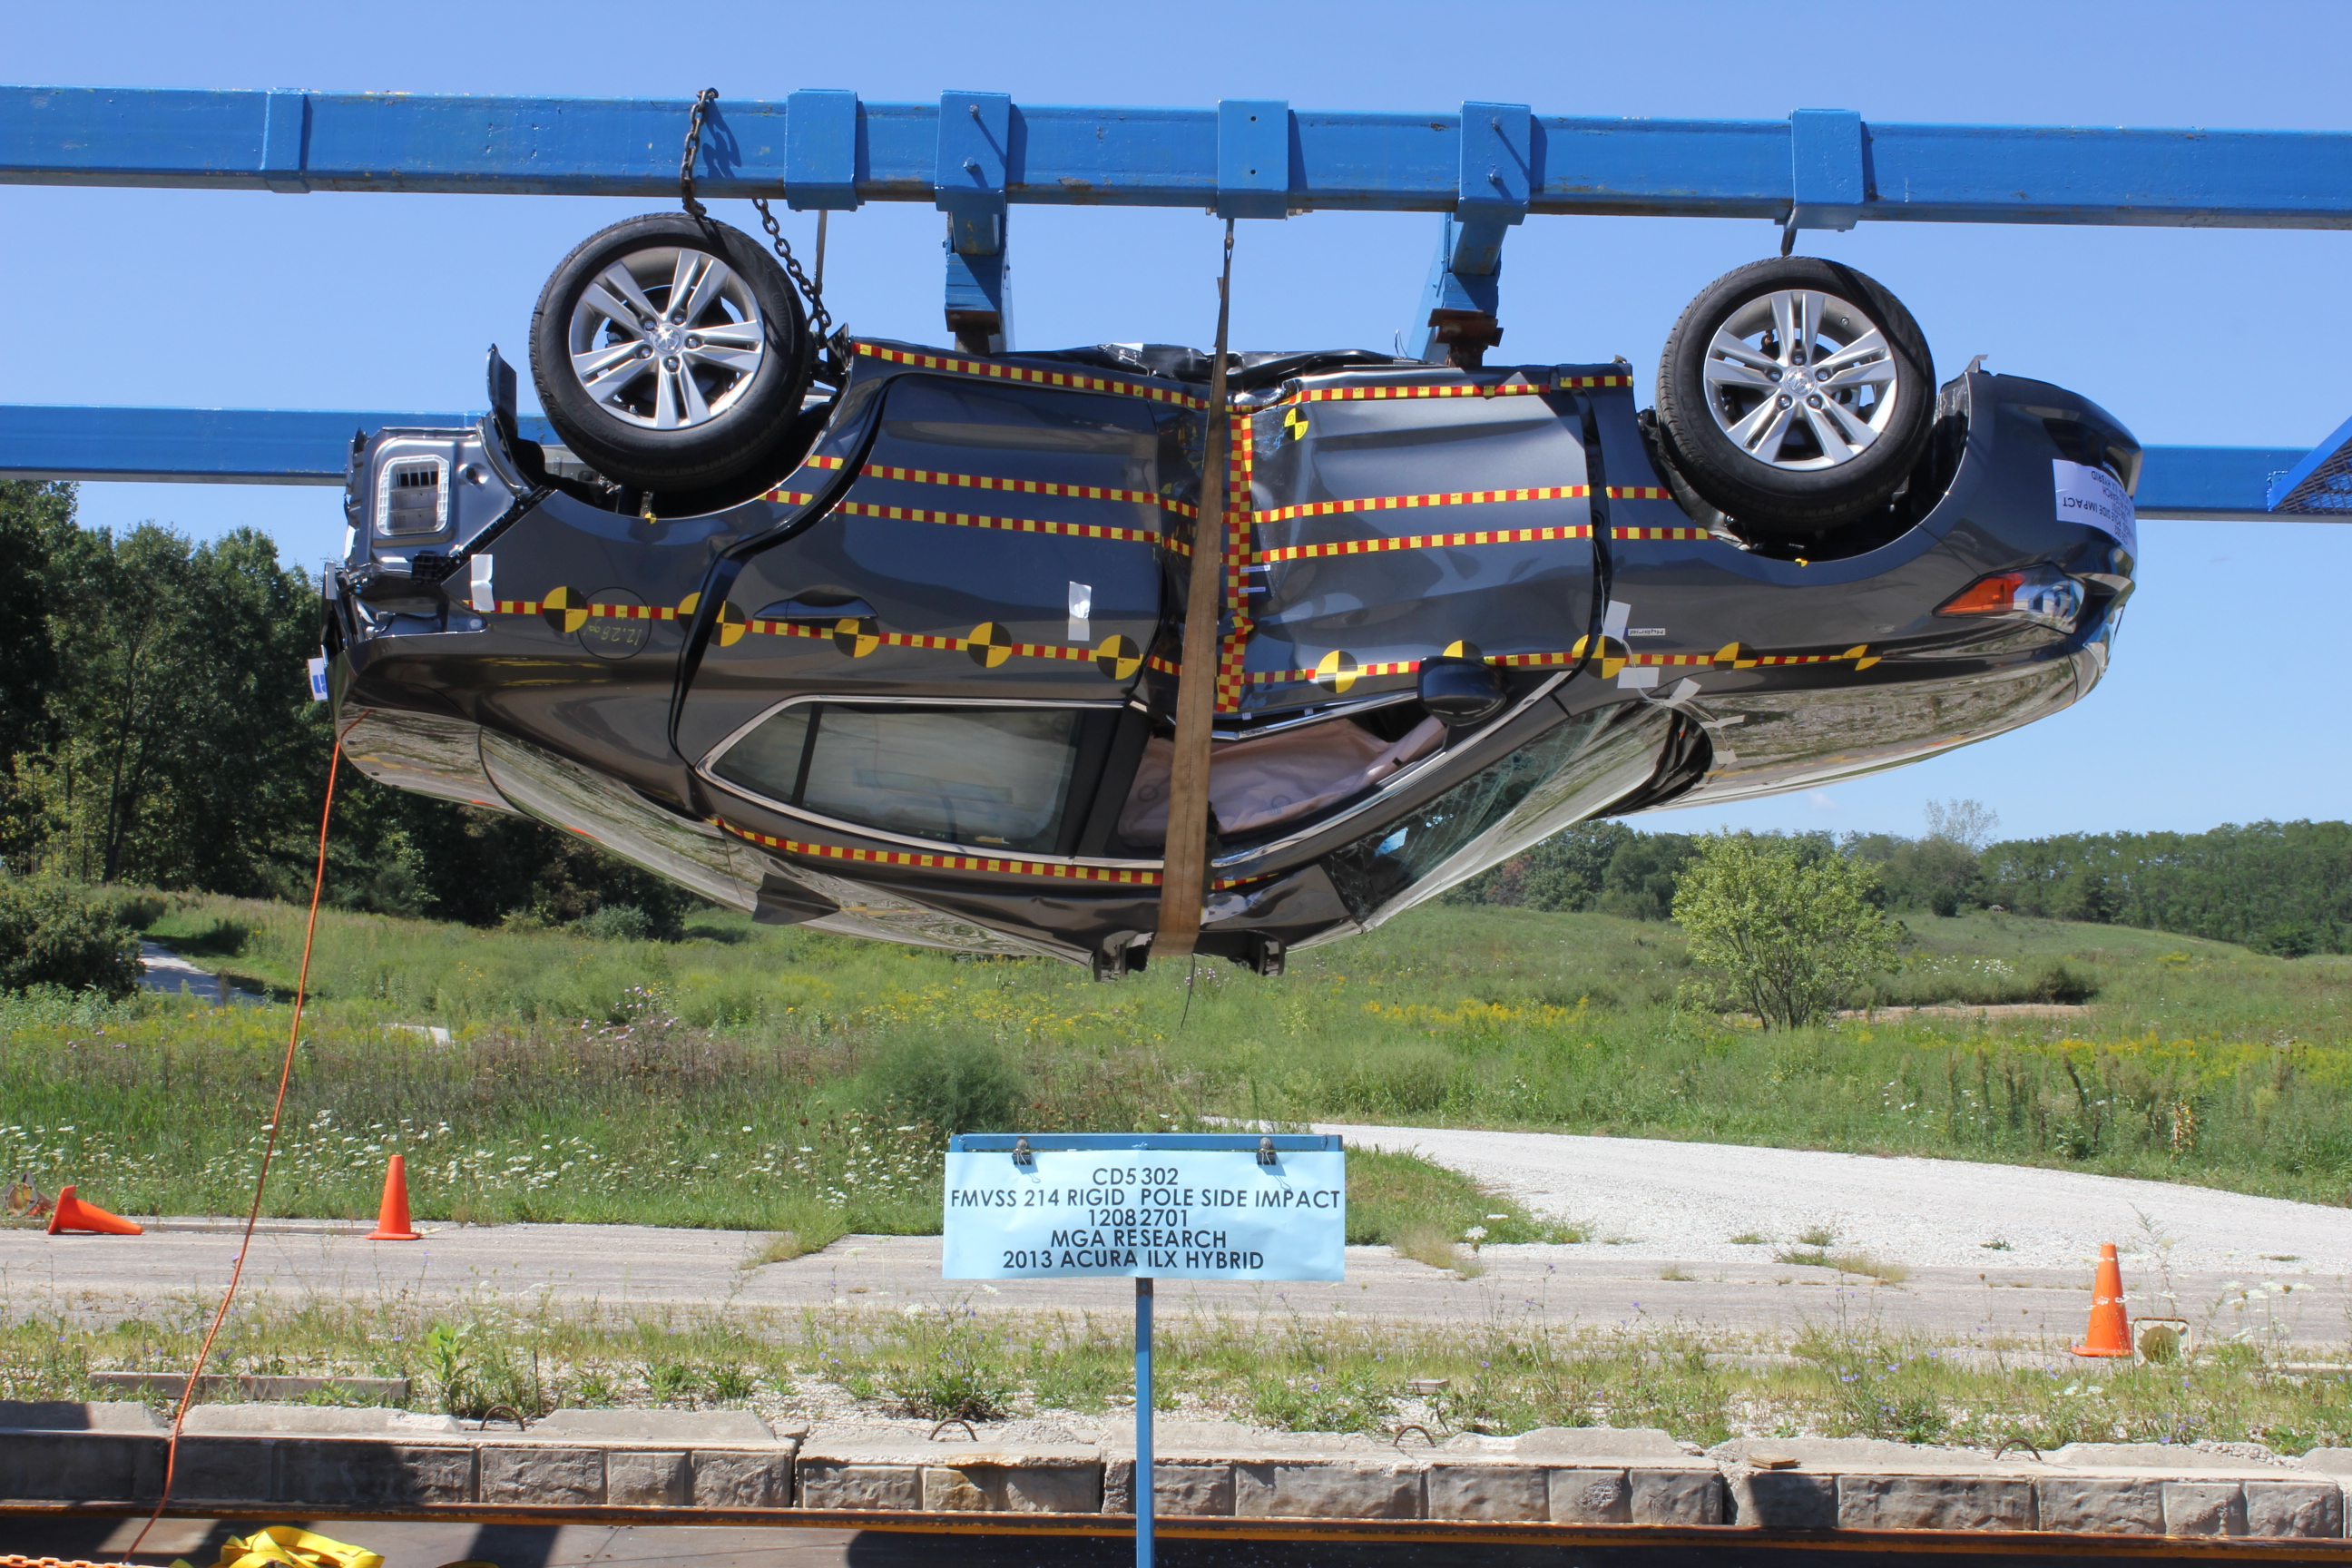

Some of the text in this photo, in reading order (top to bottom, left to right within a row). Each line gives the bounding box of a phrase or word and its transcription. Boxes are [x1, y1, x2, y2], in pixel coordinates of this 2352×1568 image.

[2063, 496, 2098, 514] IMPACT
[601, 625, 642, 646] 12.28
[951, 1188, 1340, 1209] FMVSS 214 RIGID POLE SIDE IMPACT
[1089, 1208, 1187, 1228] 12082701
[1050, 1229, 1227, 1249] MGA RESEARCH
[1003, 1249, 1264, 1269] 2013 ACURA ILX HYBRID
